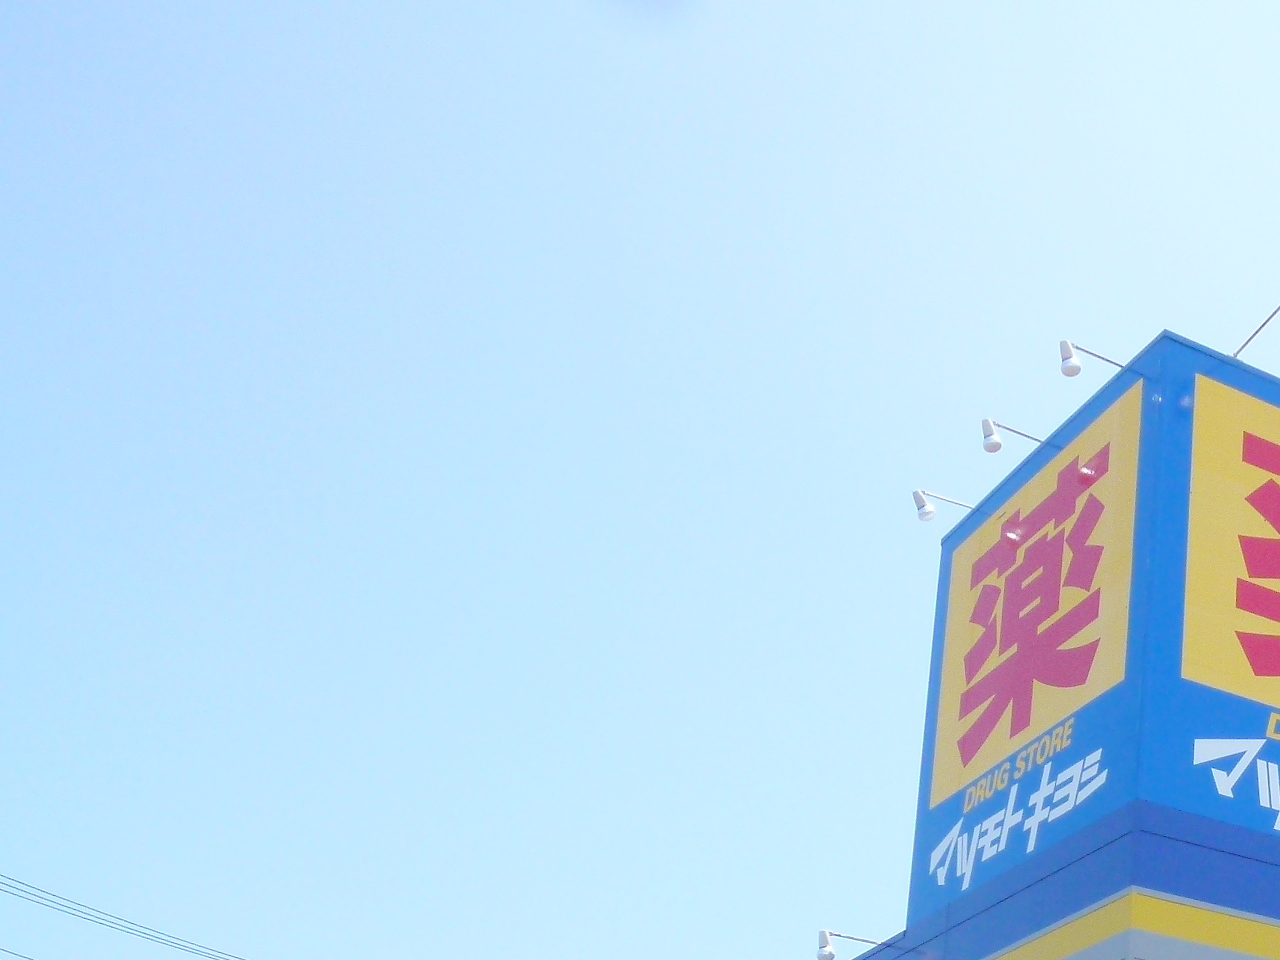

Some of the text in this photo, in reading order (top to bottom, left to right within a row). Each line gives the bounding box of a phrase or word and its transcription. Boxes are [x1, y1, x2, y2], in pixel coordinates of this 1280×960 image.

[957, 441, 1110, 767] 薬
[929, 748, 1108, 891] マツモトキヨシ
[963, 718, 1075, 814] DRUG STORE
